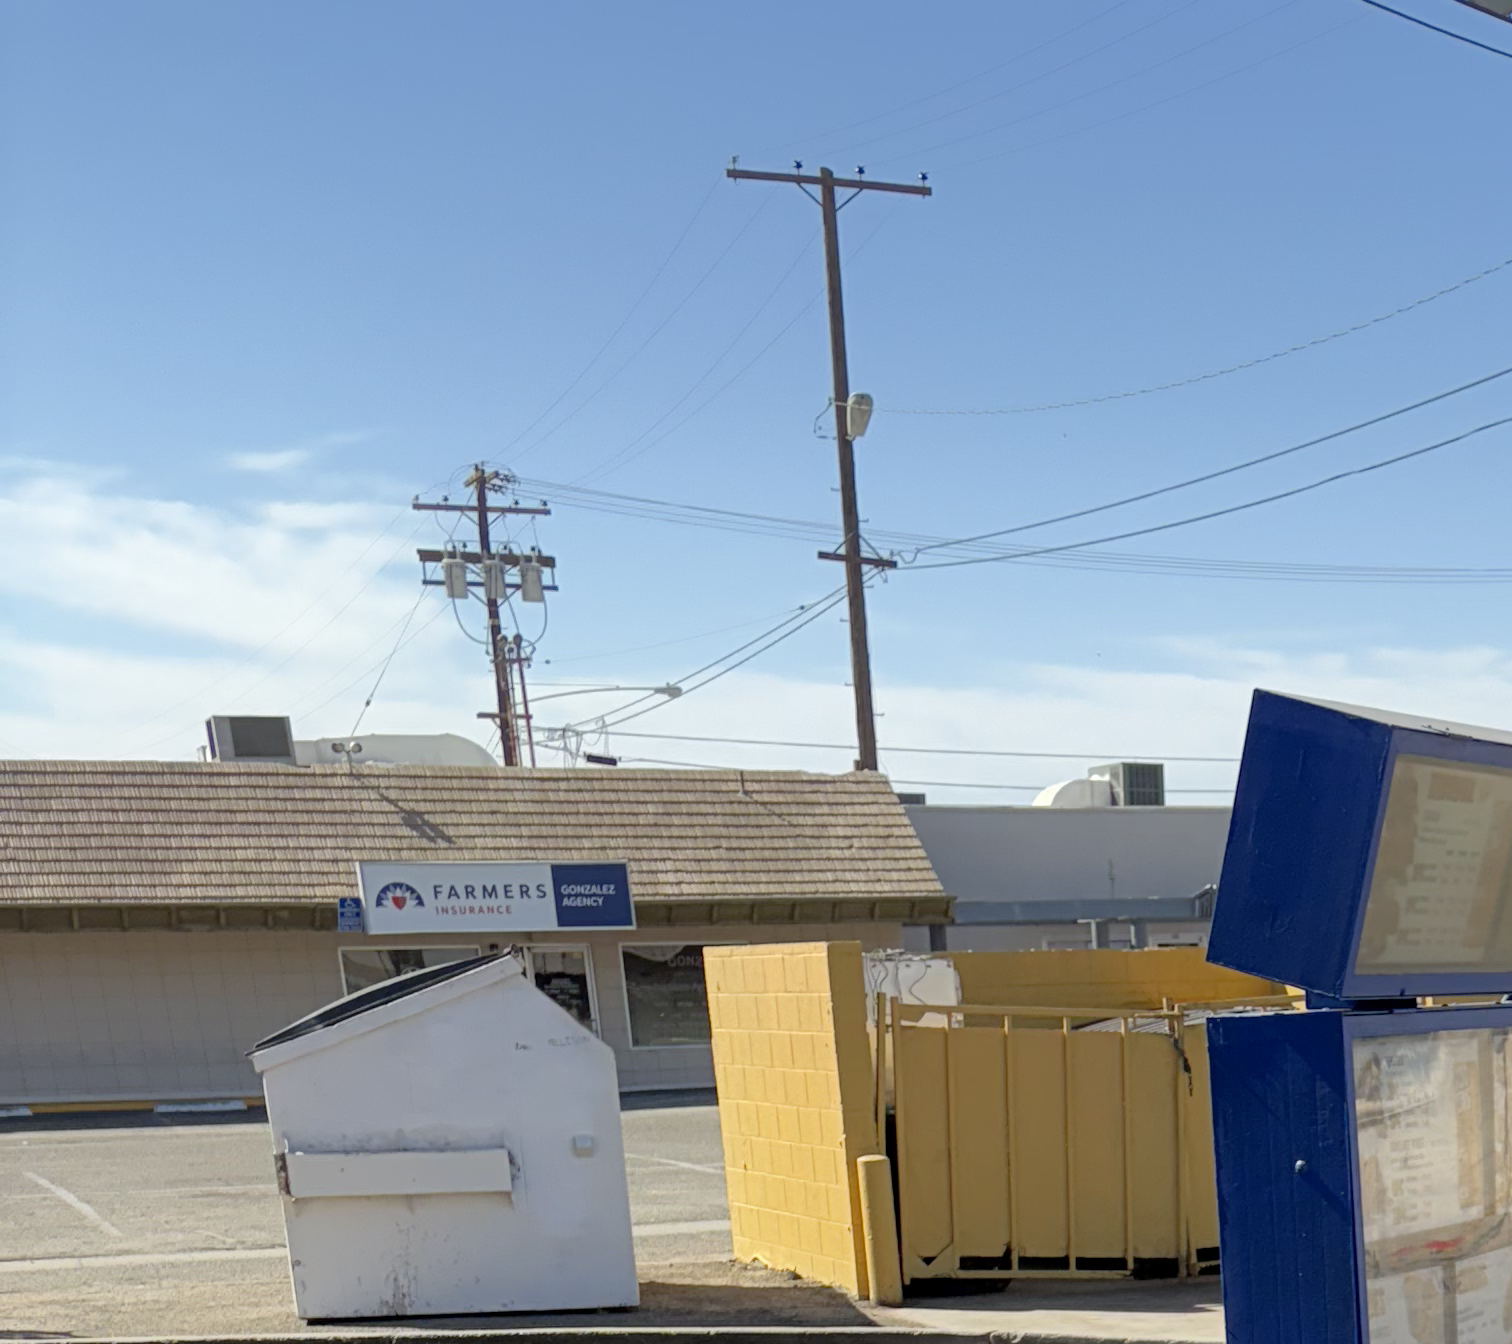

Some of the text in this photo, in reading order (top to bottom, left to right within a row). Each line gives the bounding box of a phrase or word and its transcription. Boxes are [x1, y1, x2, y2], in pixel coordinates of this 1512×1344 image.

[433, 884, 547, 899] FARMERS
[560, 884, 616, 895] GONZALEZ
[561, 896, 604, 907] AGENCY
[435, 904, 512, 916] INSURANCE
